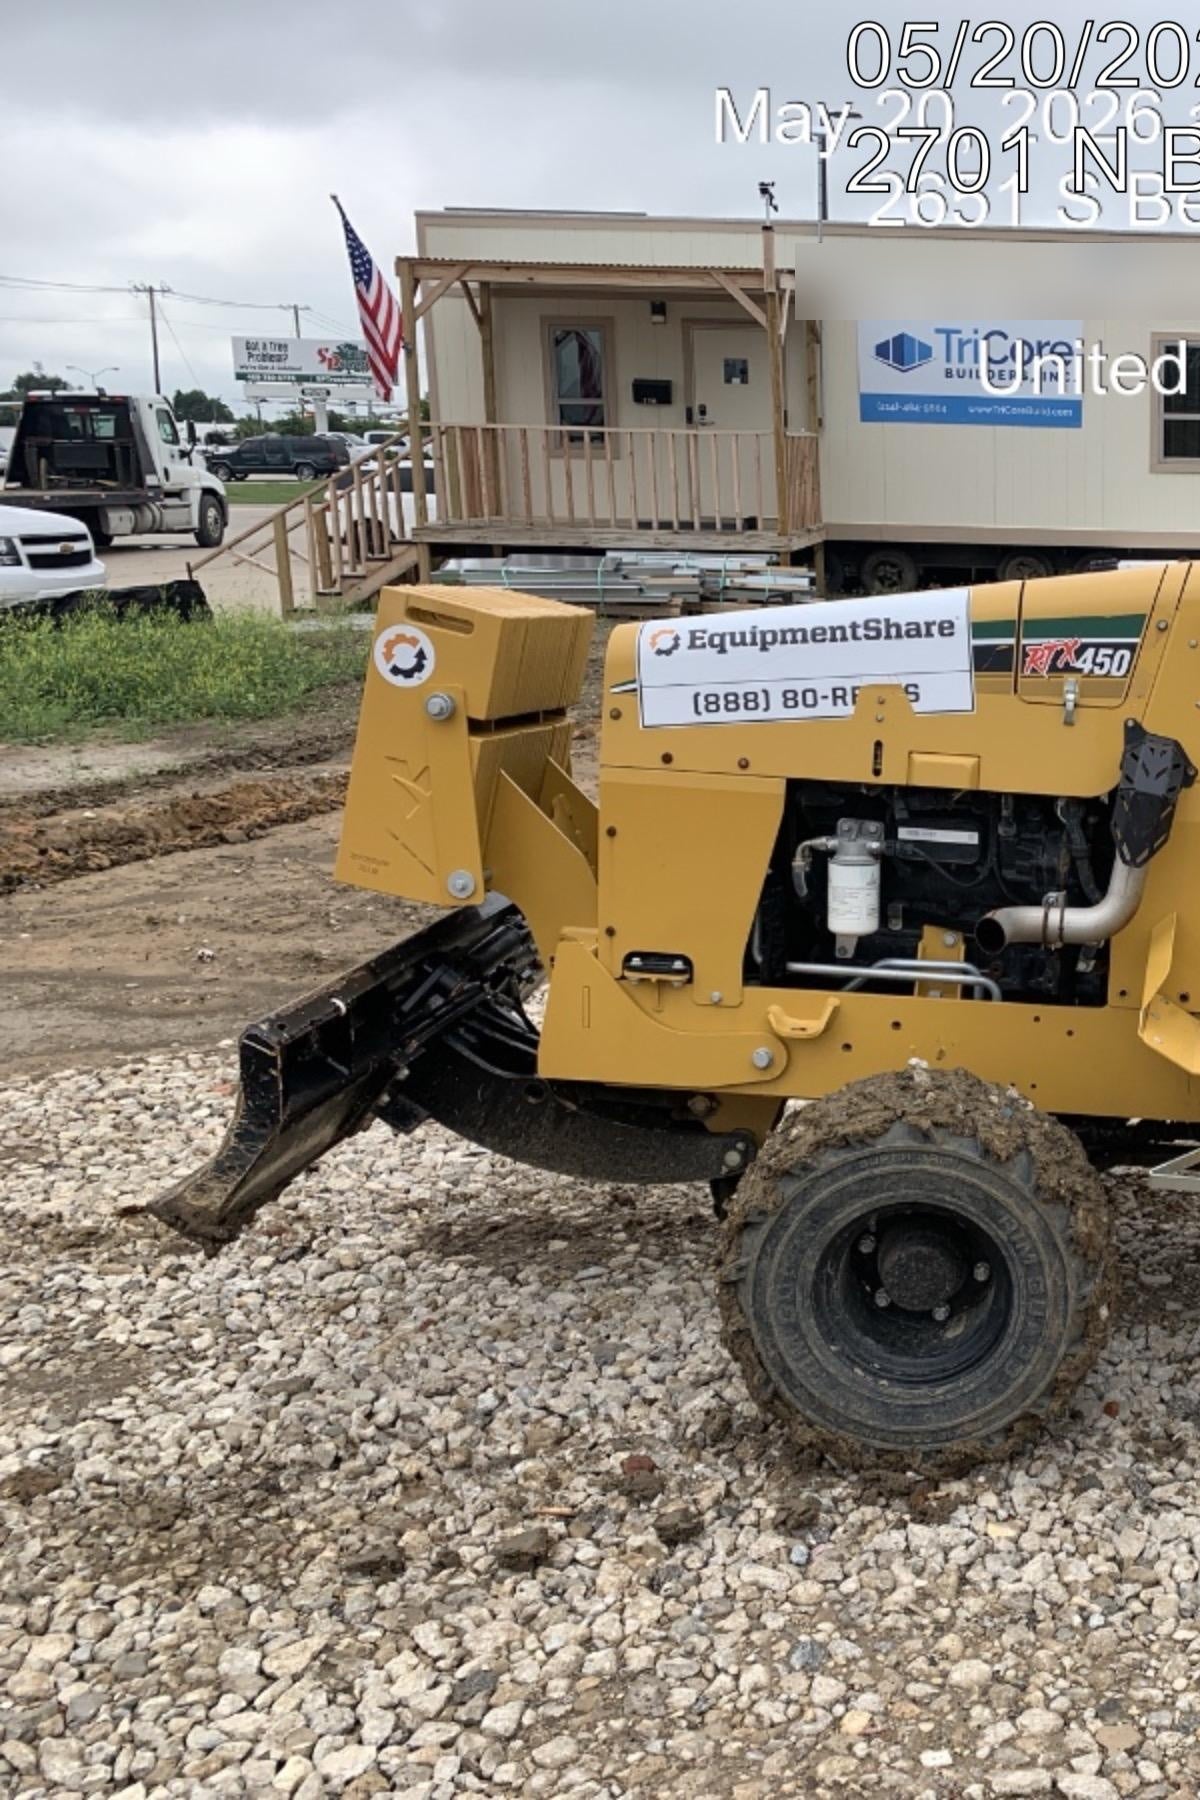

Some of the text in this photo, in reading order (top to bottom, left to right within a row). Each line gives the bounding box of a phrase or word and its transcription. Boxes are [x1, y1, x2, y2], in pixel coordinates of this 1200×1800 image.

[934, 328, 1074, 366] TriCore
[687, 617, 956, 654] EquipmentShare
[693, 689, 771, 716] (888)
